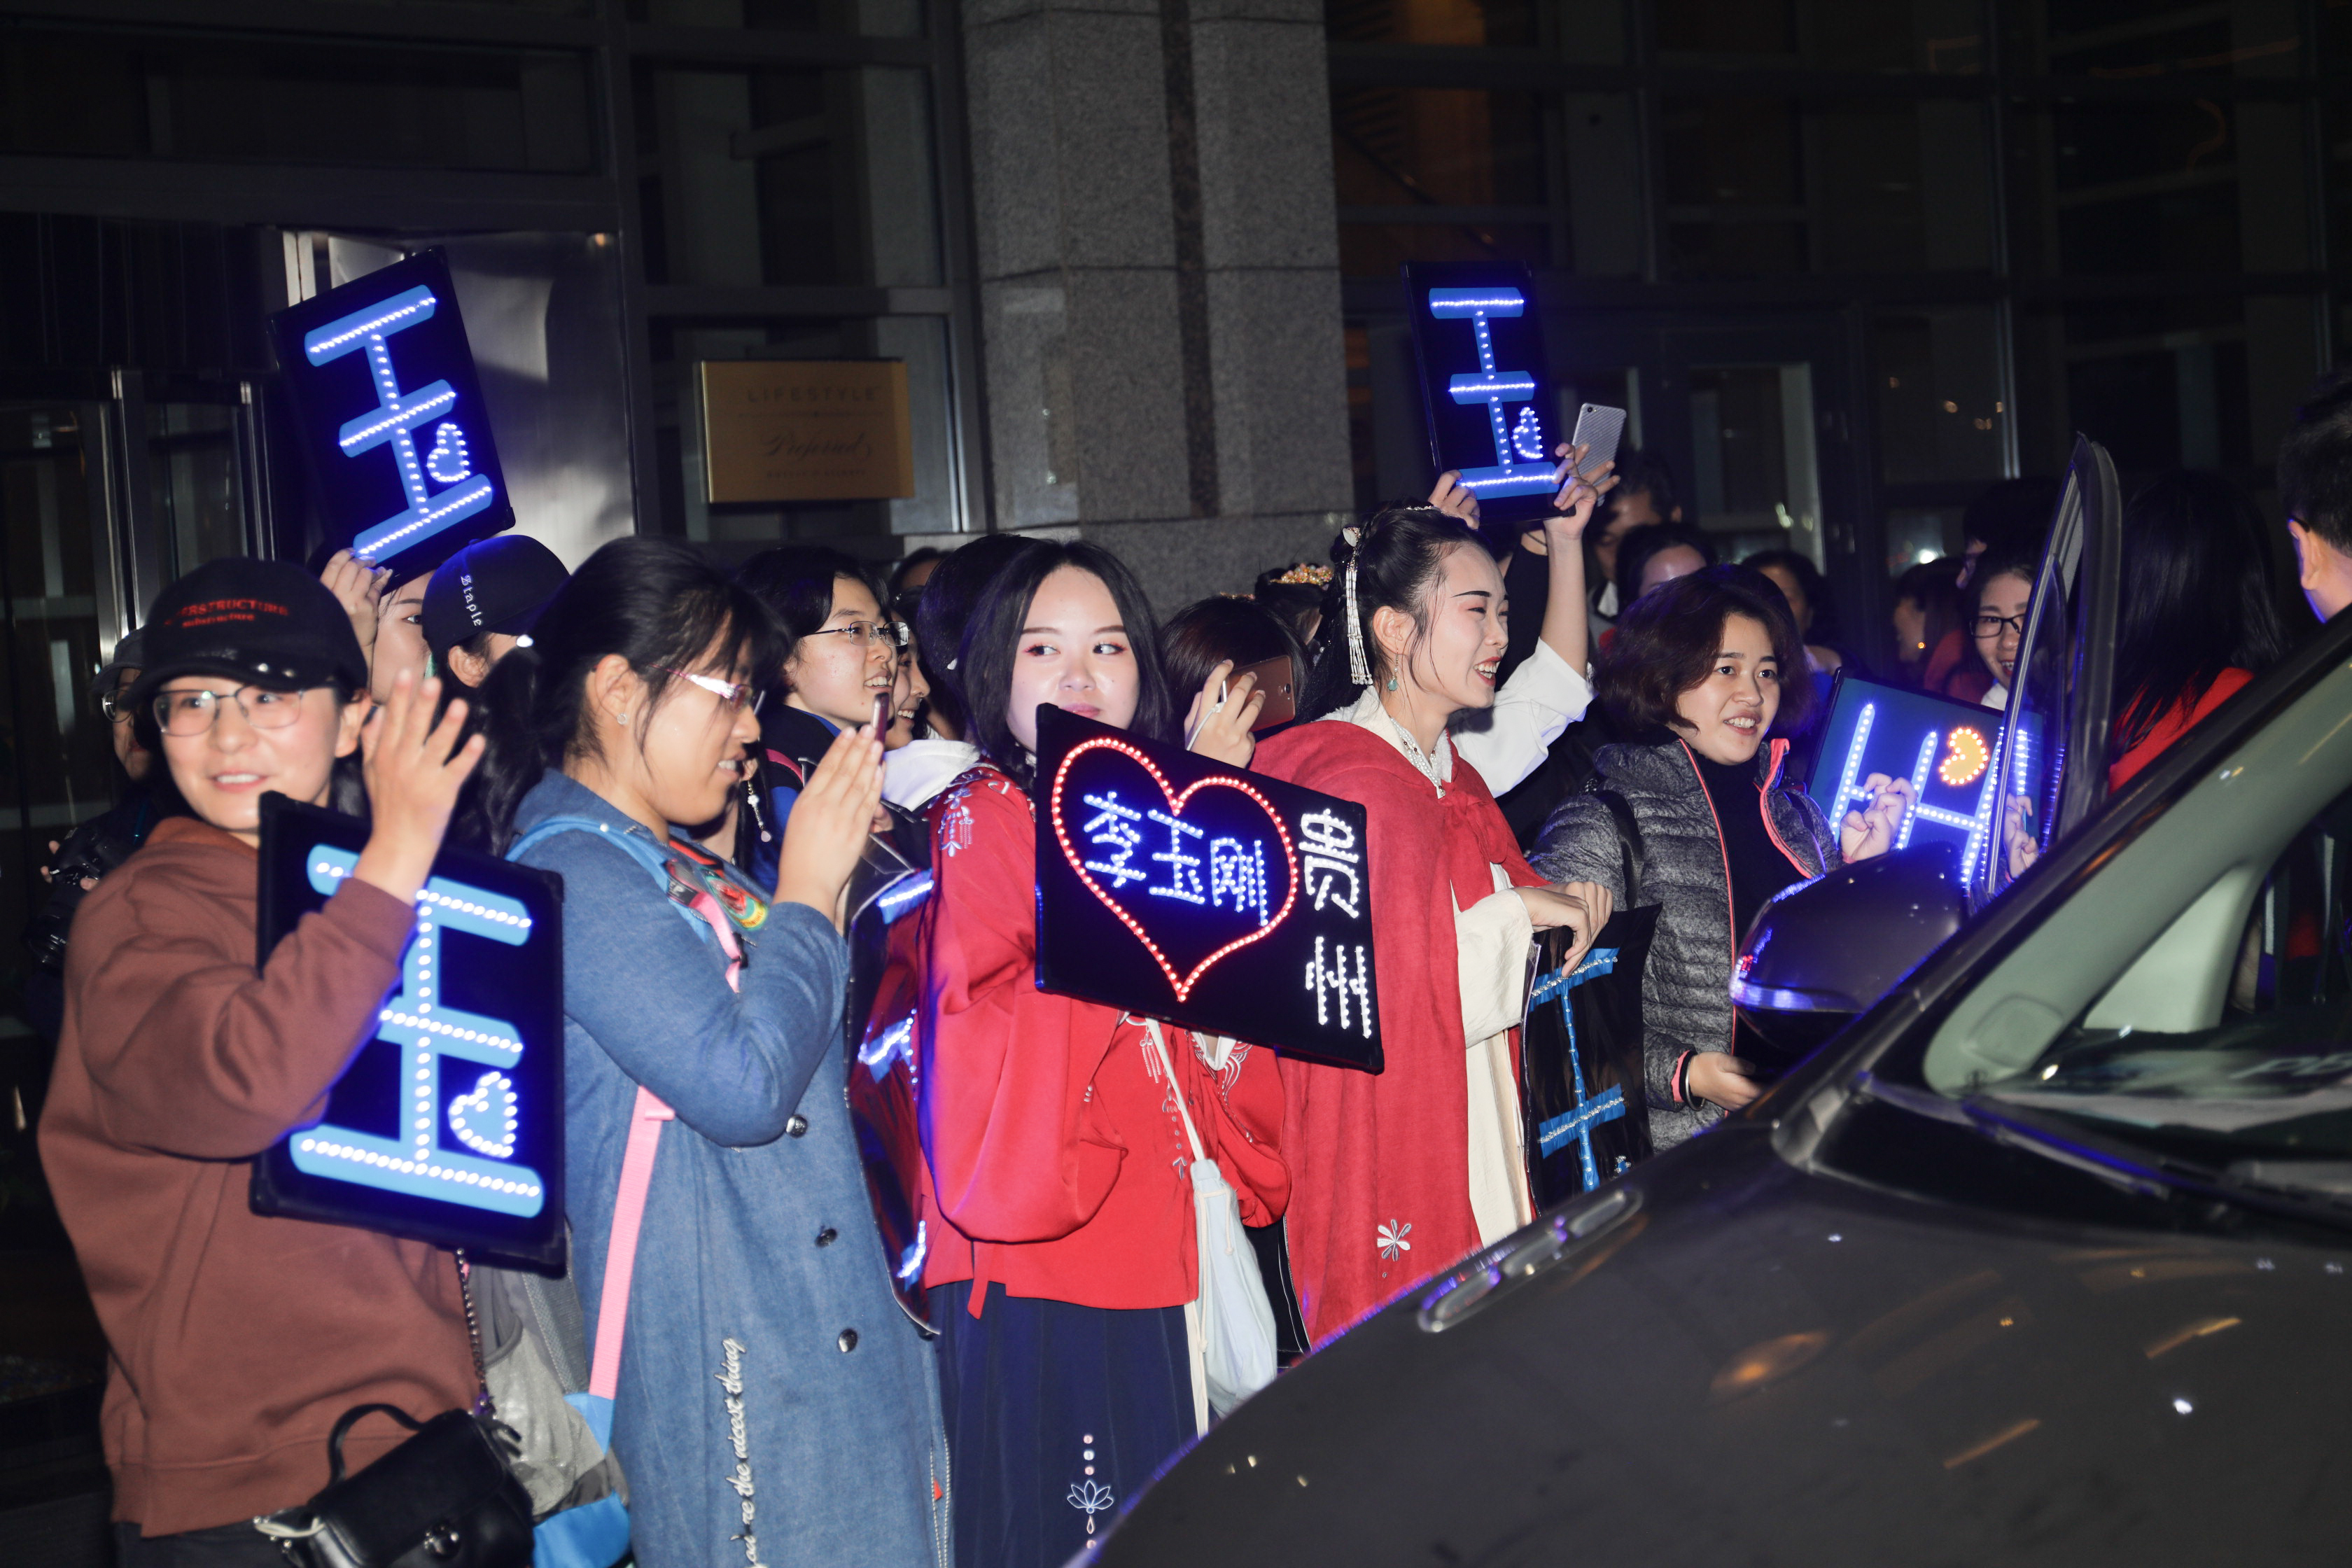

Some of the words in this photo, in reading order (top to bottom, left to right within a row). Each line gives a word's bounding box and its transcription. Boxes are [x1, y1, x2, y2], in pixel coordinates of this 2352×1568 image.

[747, 386, 875, 403] LIFESTYLE
[461, 575, 482, 626] Staple
[1084, 790, 1269, 927] 李玉刚
[1298, 808, 1372, 1039] 贵州
[713, 1336, 747, 1396] thing
[724, 1397, 749, 1459] nicest
[725, 1461, 755, 1498] the
[729, 1499, 769, 1568] ou're
